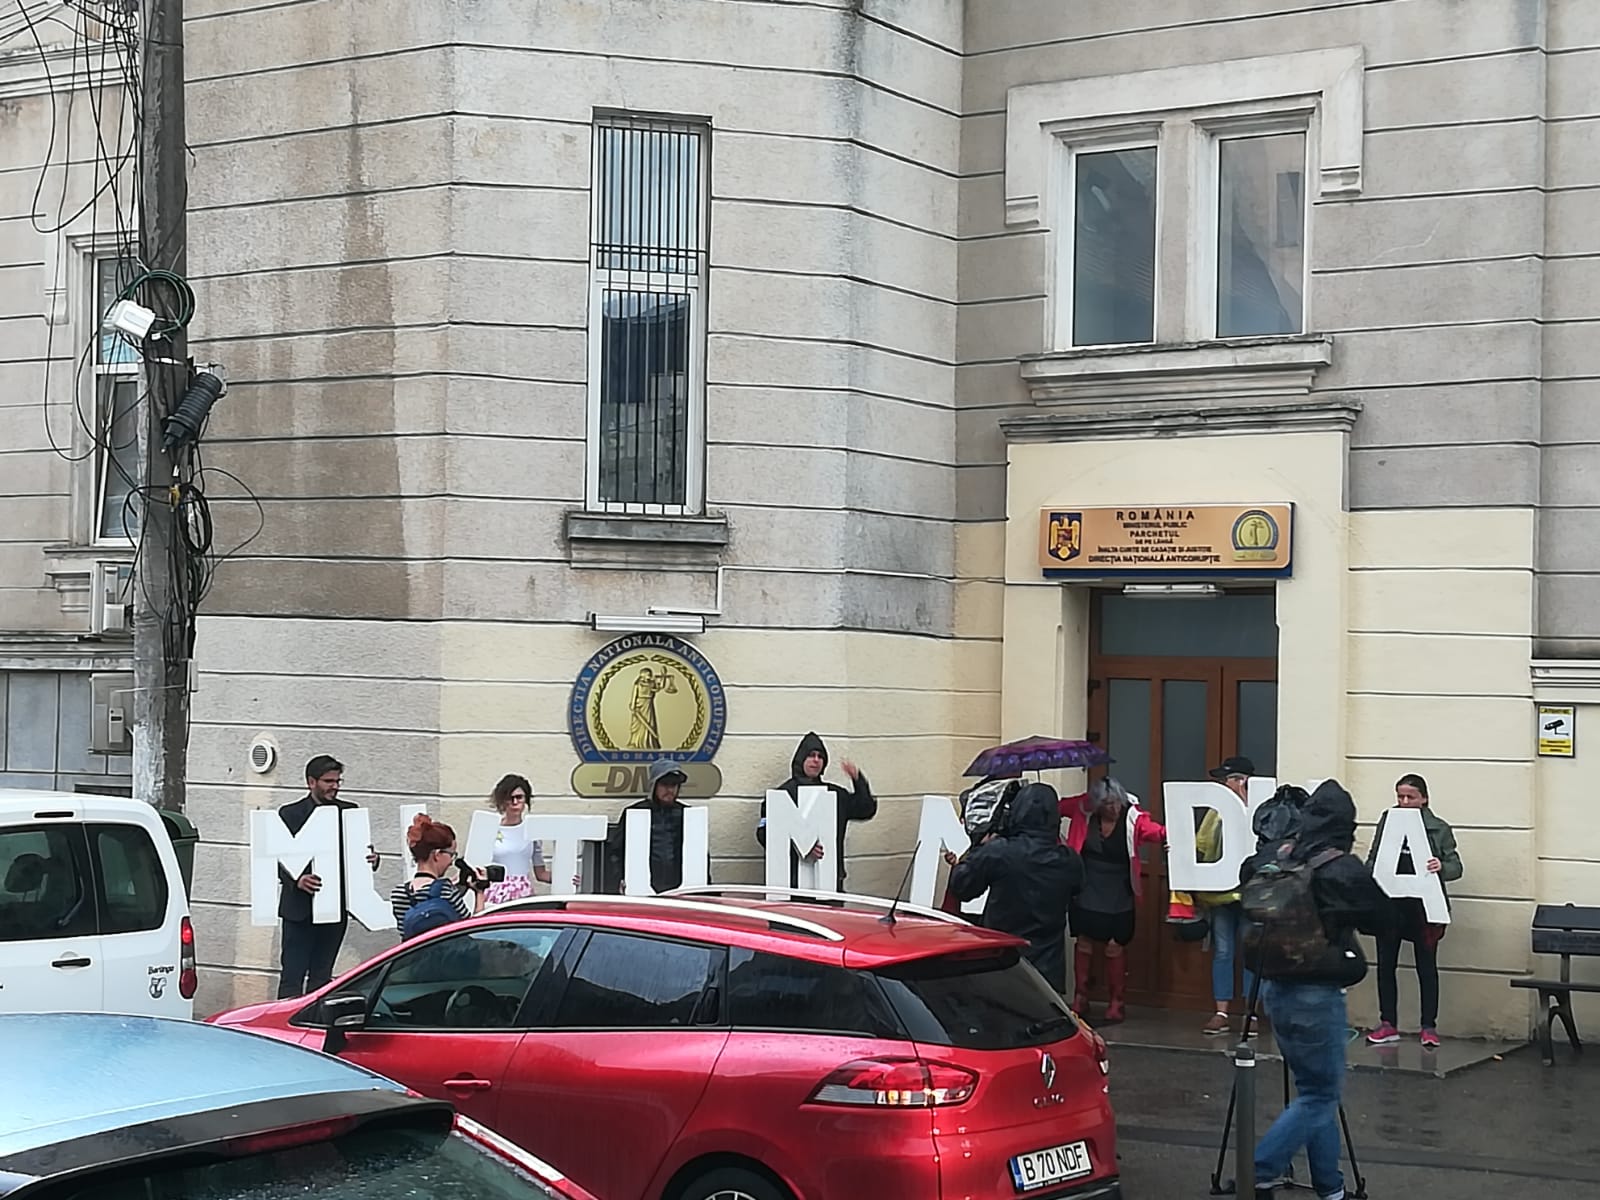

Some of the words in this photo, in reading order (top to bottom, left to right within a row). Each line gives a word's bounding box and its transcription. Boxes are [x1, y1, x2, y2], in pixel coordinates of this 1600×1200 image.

[1116, 508, 1195, 520] ROMÂNIA
[1130, 530, 1180, 538] PARCHETUL
[573, 676, 592, 754] DIRECTIA
[588, 635, 675, 672] NATIONALA
[678, 645, 724, 754] ANTICORUPTIE
[1022, 1157, 1036, 1181] B
[1036, 1152, 1056, 1178] 70
[1055, 1145, 1083, 1173] NDF
